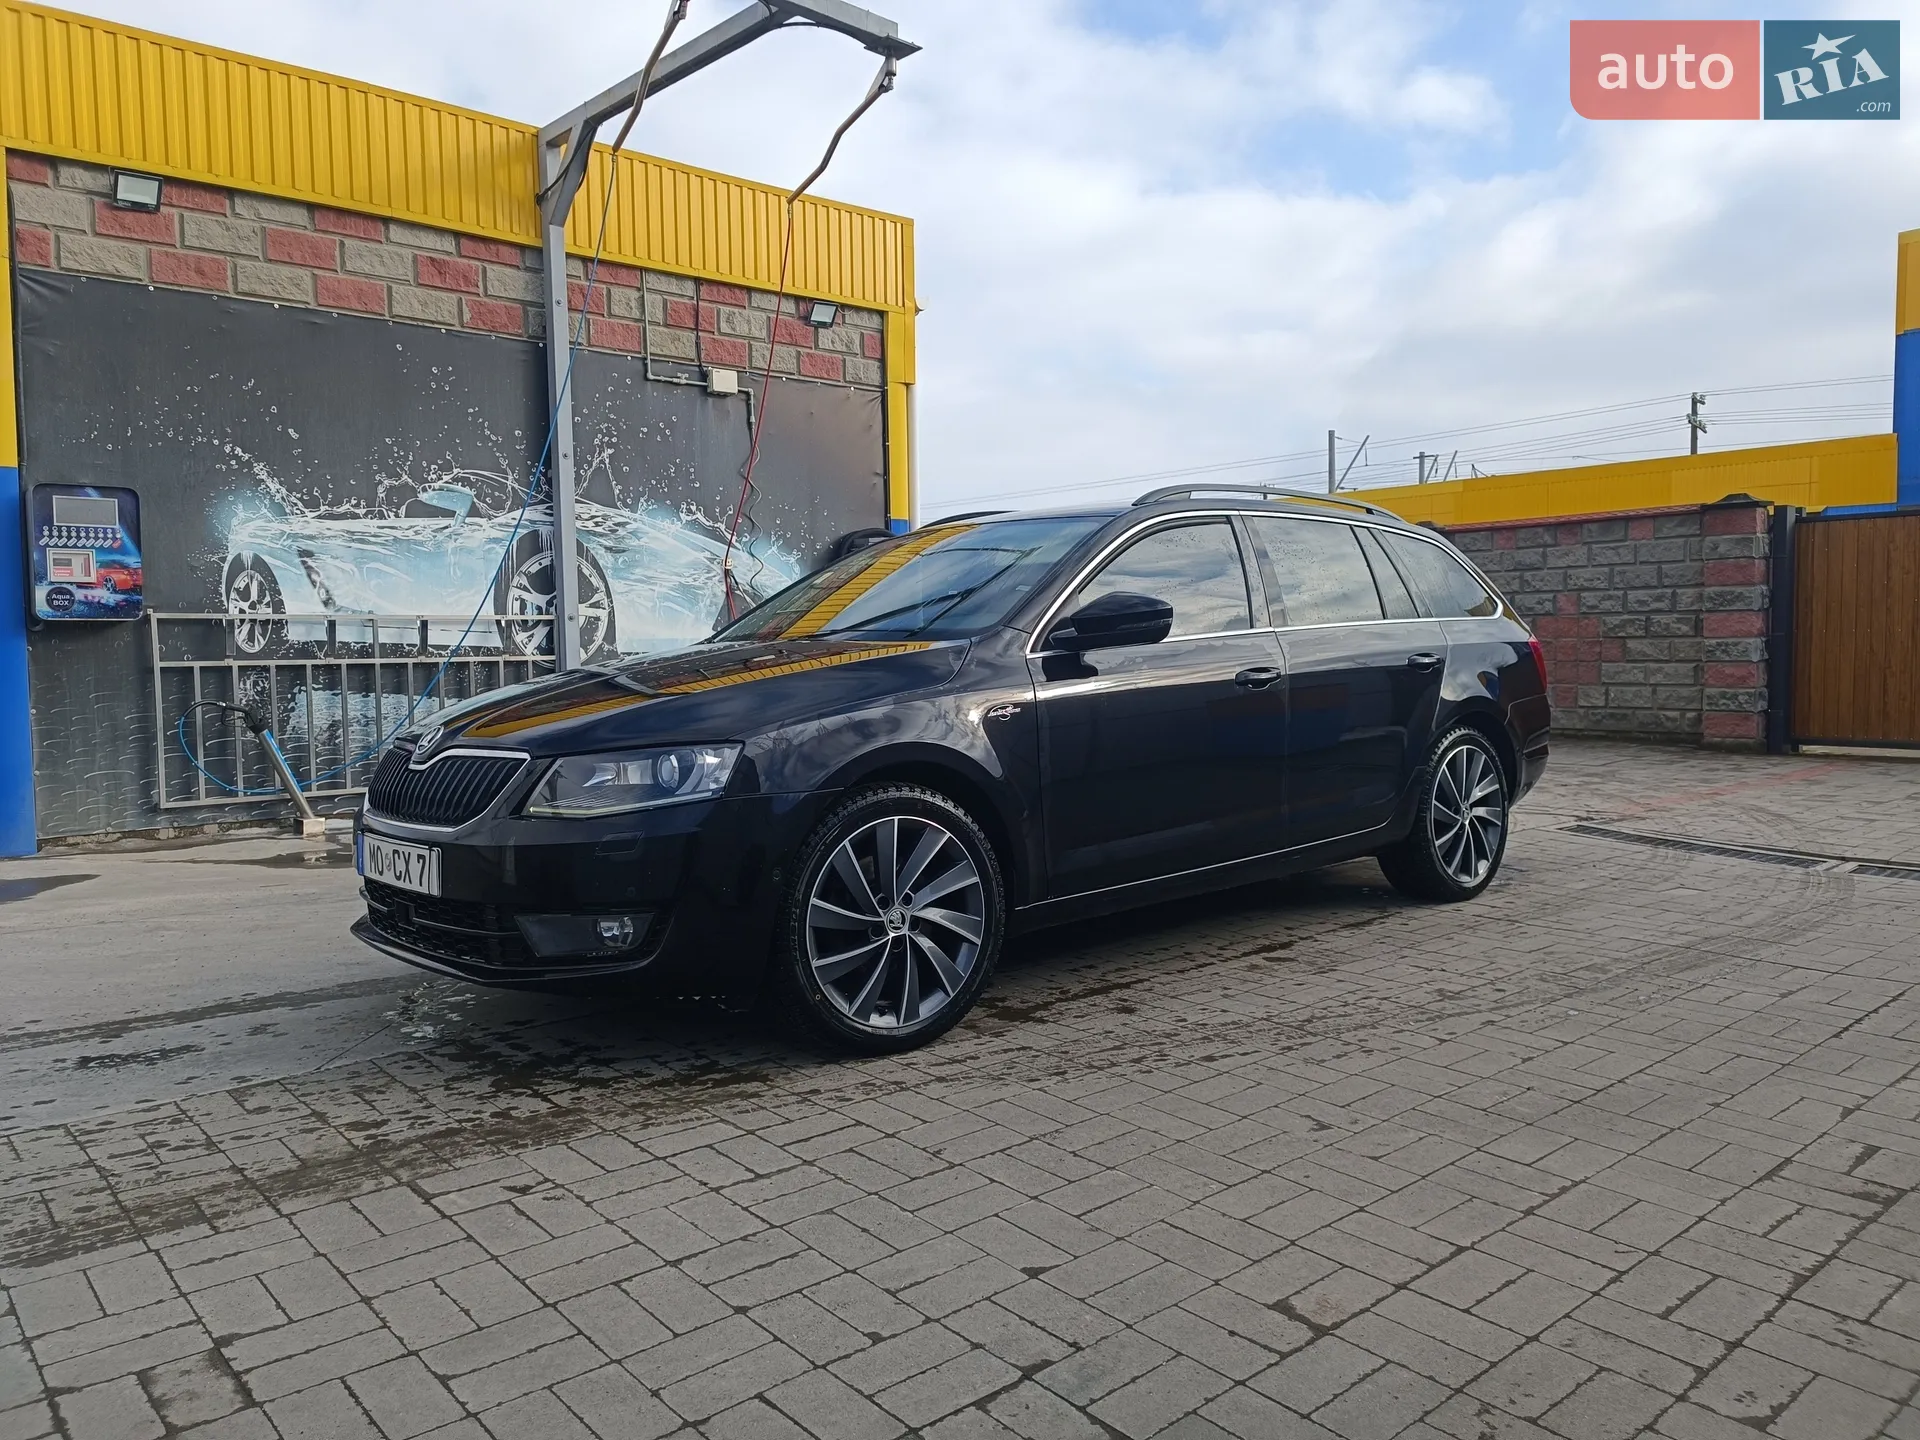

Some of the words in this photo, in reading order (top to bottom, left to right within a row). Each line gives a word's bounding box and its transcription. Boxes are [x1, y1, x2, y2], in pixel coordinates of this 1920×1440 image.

[52, 593, 71, 602] Aqua
[368, 842, 384, 876] MO
[392, 849, 412, 885] CX
[416, 853, 426, 887] 7
